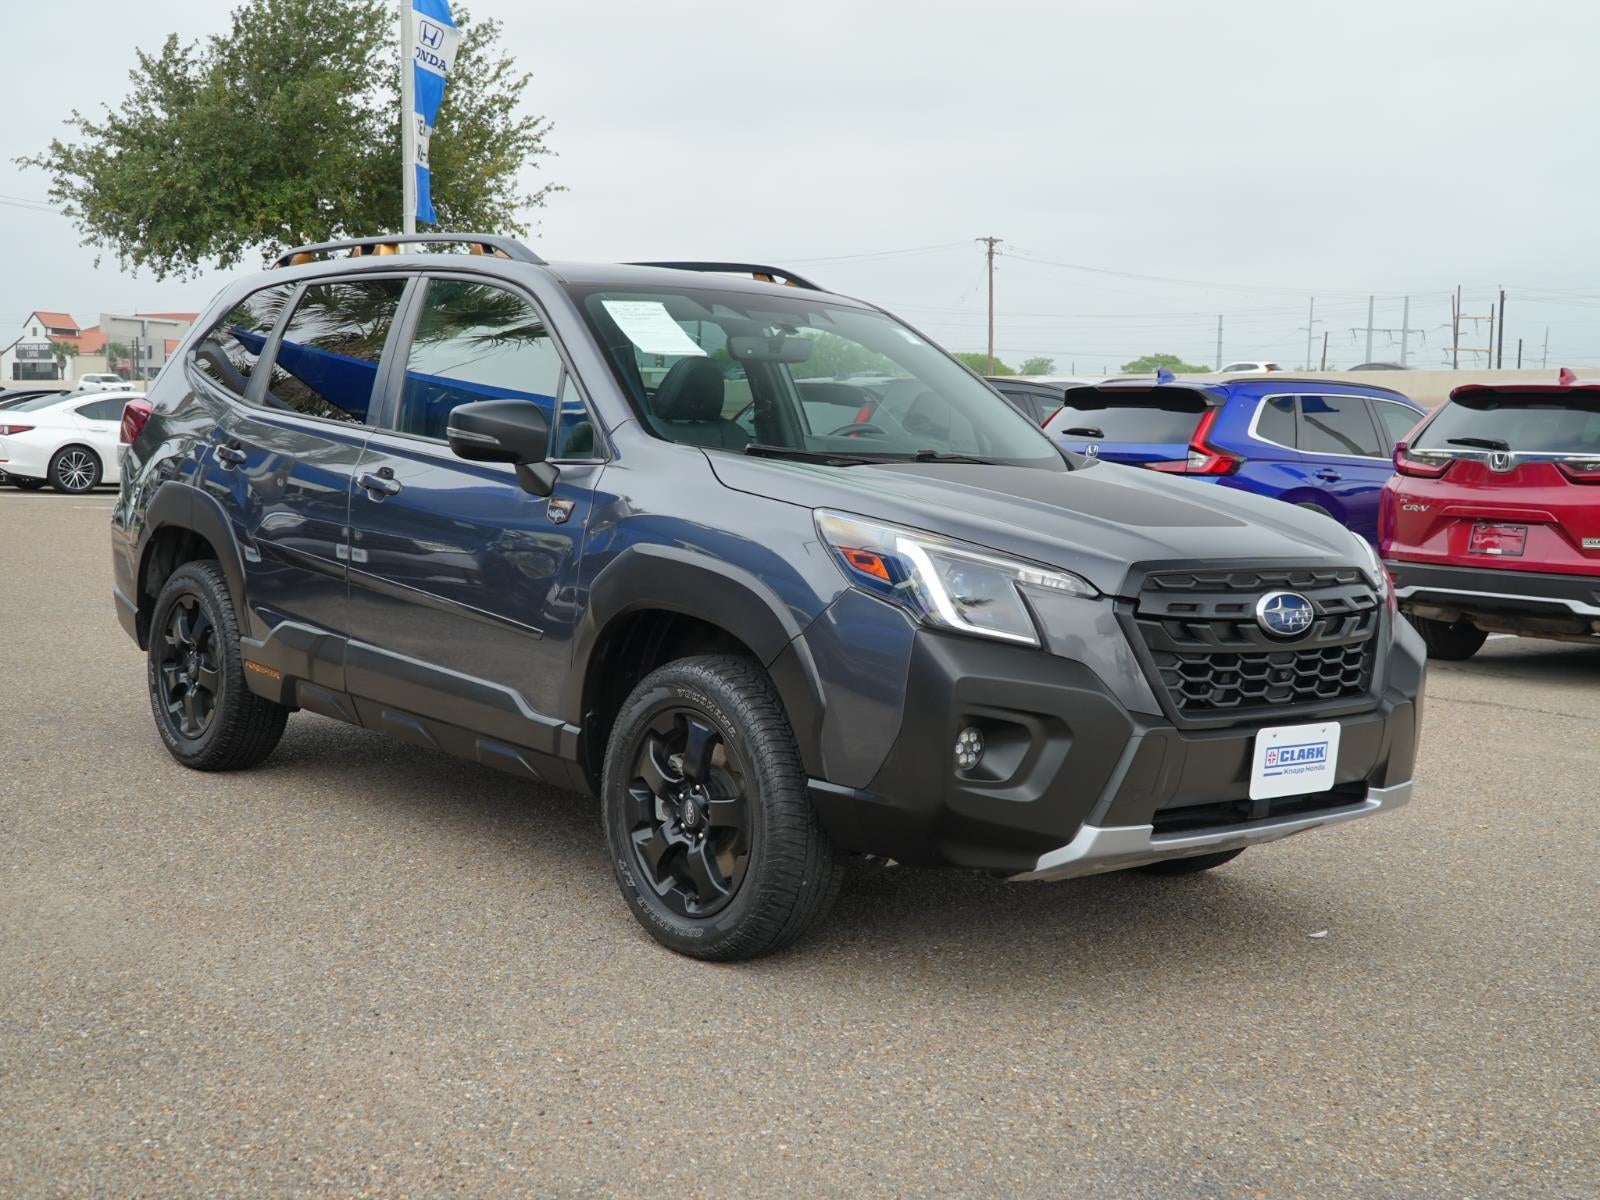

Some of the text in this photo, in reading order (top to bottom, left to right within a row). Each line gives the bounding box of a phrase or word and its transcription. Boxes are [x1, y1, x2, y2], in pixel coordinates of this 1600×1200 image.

[416, 46, 447, 71] ONDA
[1279, 747, 1325, 762] CLARK
[1283, 766, 1304, 775] Knapp
